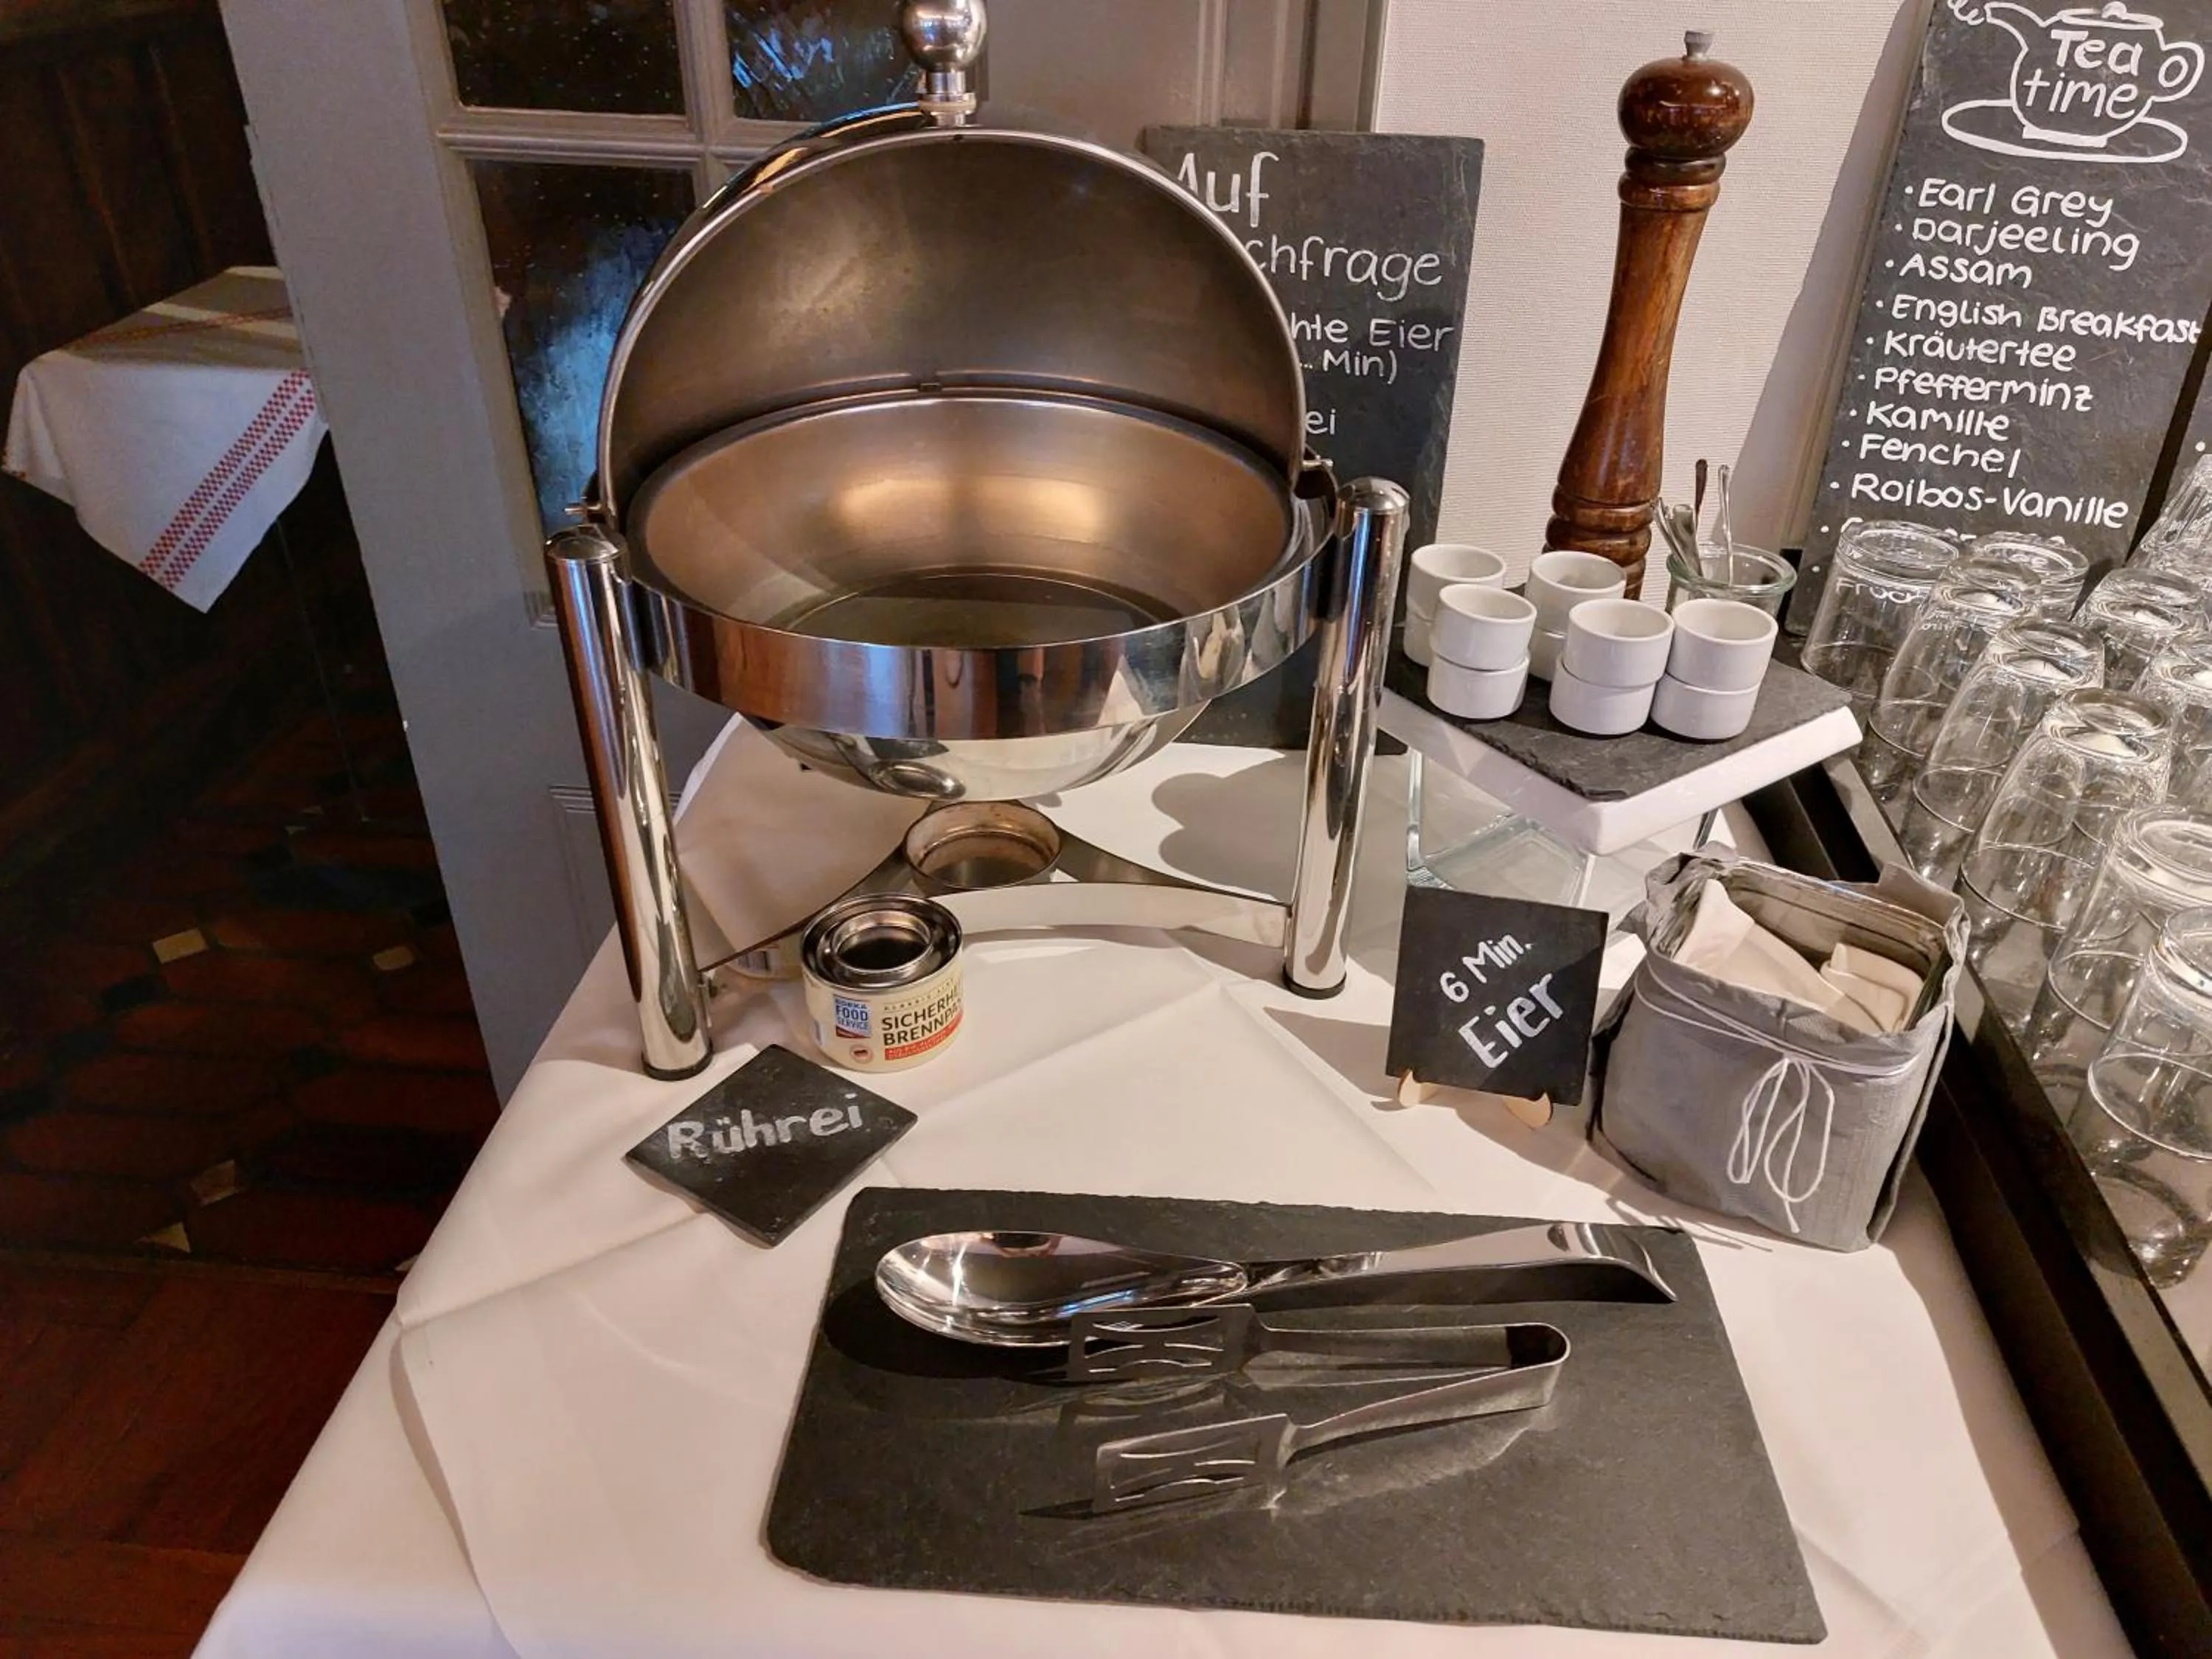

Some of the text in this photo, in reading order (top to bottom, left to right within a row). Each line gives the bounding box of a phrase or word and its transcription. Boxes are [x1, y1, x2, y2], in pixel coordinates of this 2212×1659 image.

[2051, 29, 2143, 76] Tea
[2023, 68, 2138, 120] time
[1177, 150, 1280, 228] Auf
[1918, 178, 2114, 227] Earl Grey
[1245, 234, 1443, 302] chfrage
[1912, 218, 2140, 271] Darjeeling
[1899, 253, 2033, 288] Assam
[1291, 312, 1455, 352] hte Eier
[1891, 294, 2202, 344] English Breakfast
[1322, 349, 1397, 385] Min)
[1883, 330, 2077, 372] Kräutertee
[1874, 366, 2093, 412] Pfefferminz
[1865, 400, 2010, 442] Kamille
[1858, 434, 2022, 479] Fenchel
[1851, 473, 2129, 529] Roibos-Vanille
[1439, 933, 1534, 1003] 6 Min.
[835, 1004, 868, 1021] FOOD
[881, 985, 958, 1032] SICHERH
[883, 998, 961, 1046] BRENNPA
[1458, 973, 1563, 1068] Eier
[667, 1093, 863, 1159] Rührei
